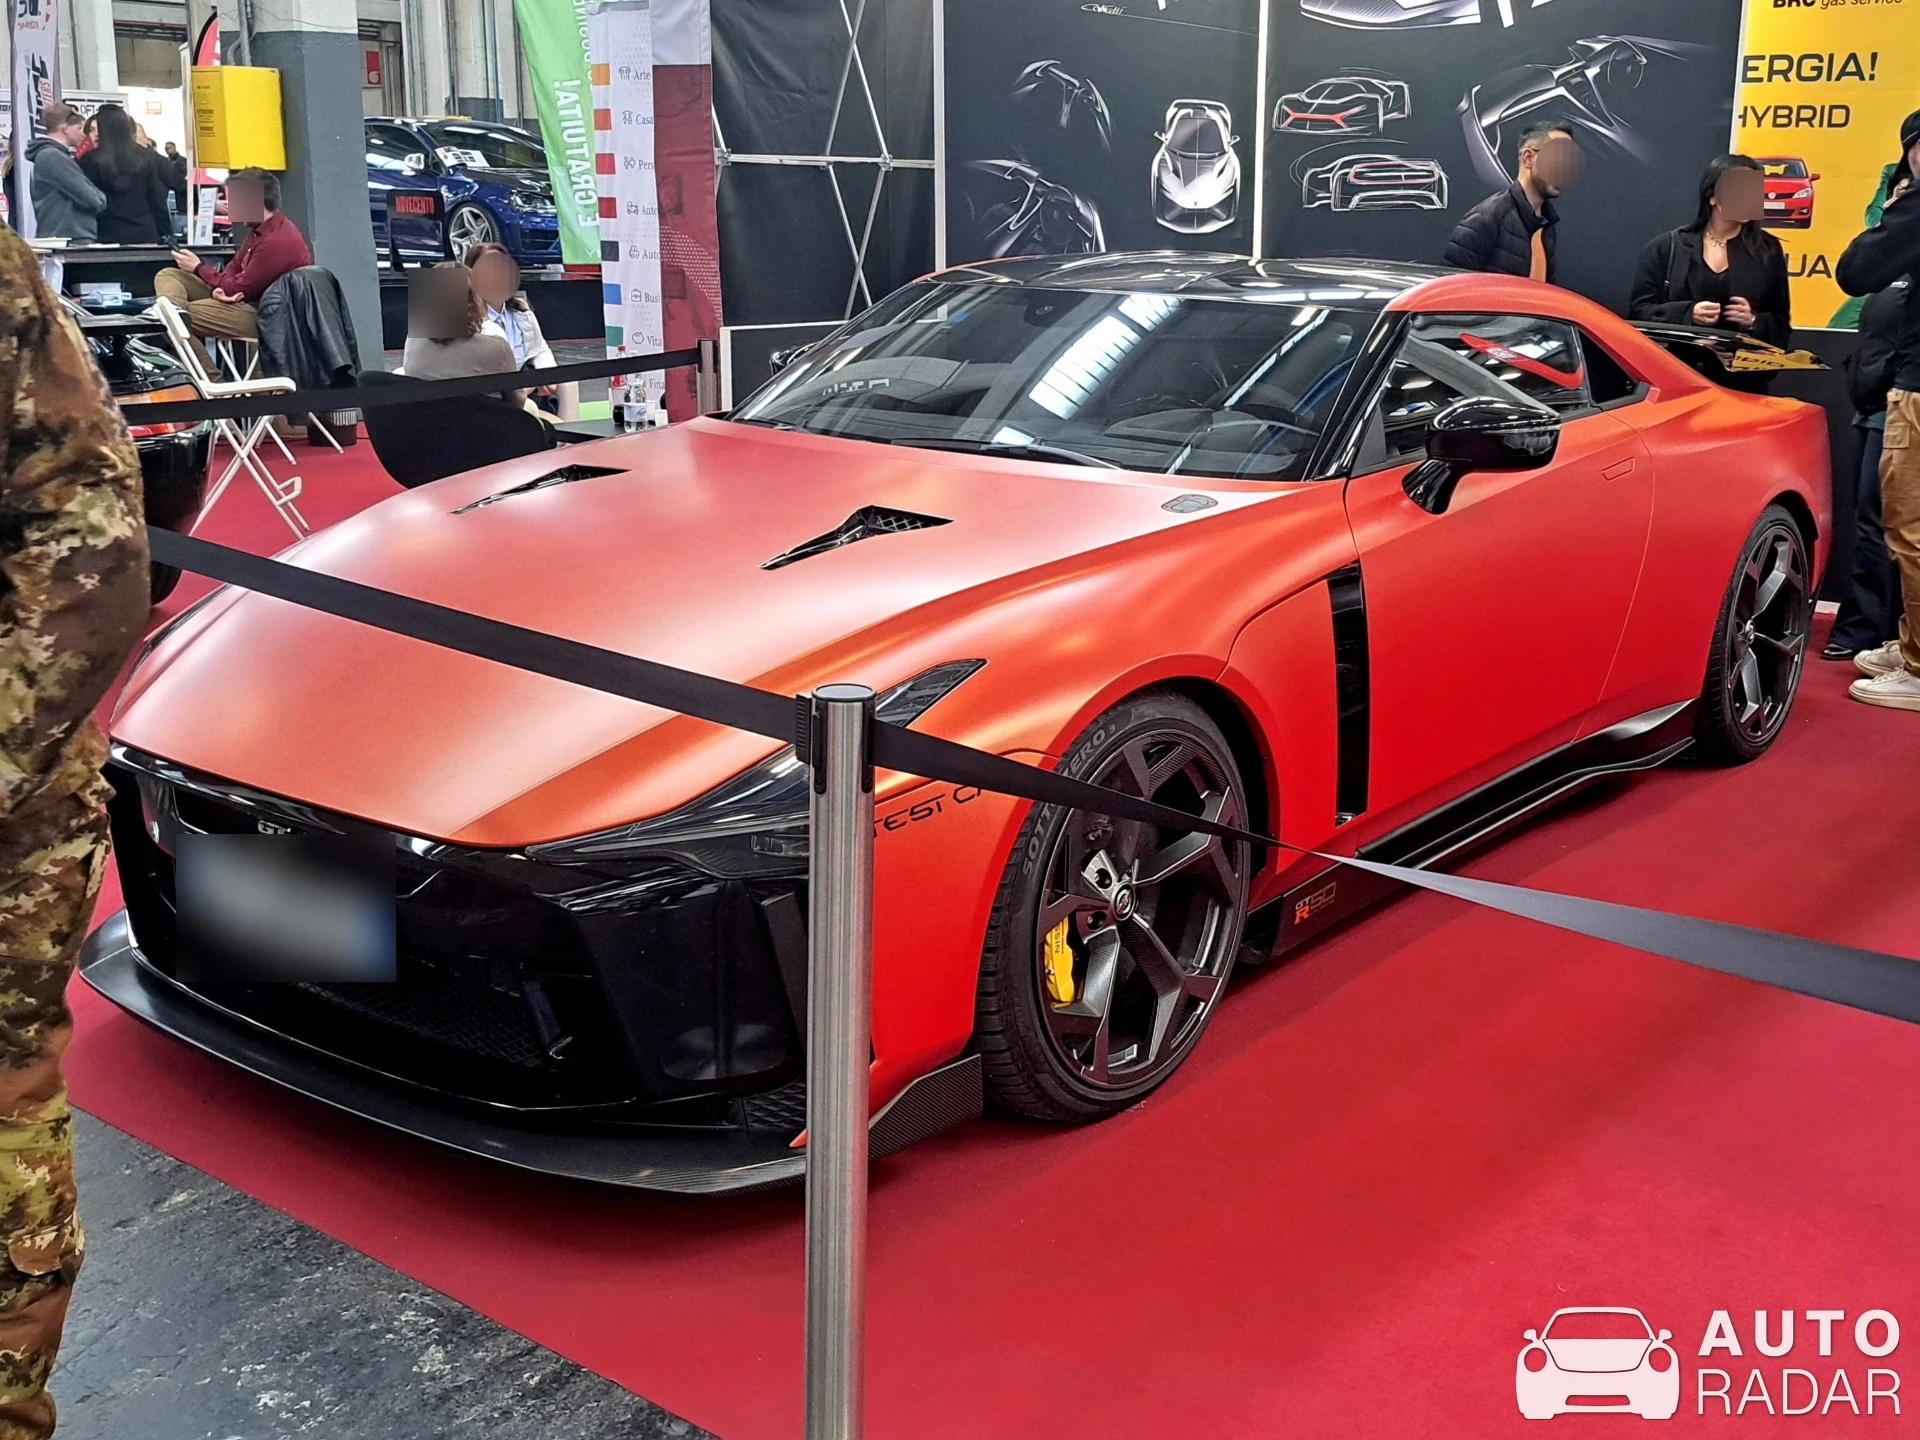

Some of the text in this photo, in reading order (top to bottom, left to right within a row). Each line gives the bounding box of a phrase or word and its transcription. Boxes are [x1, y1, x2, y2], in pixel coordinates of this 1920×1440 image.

[1741, 52, 1879, 83] ERGIA!
[634, 70, 651, 81] Arte
[395, 196, 434, 214] NOVECENTO
[646, 335, 662, 347] Vita
